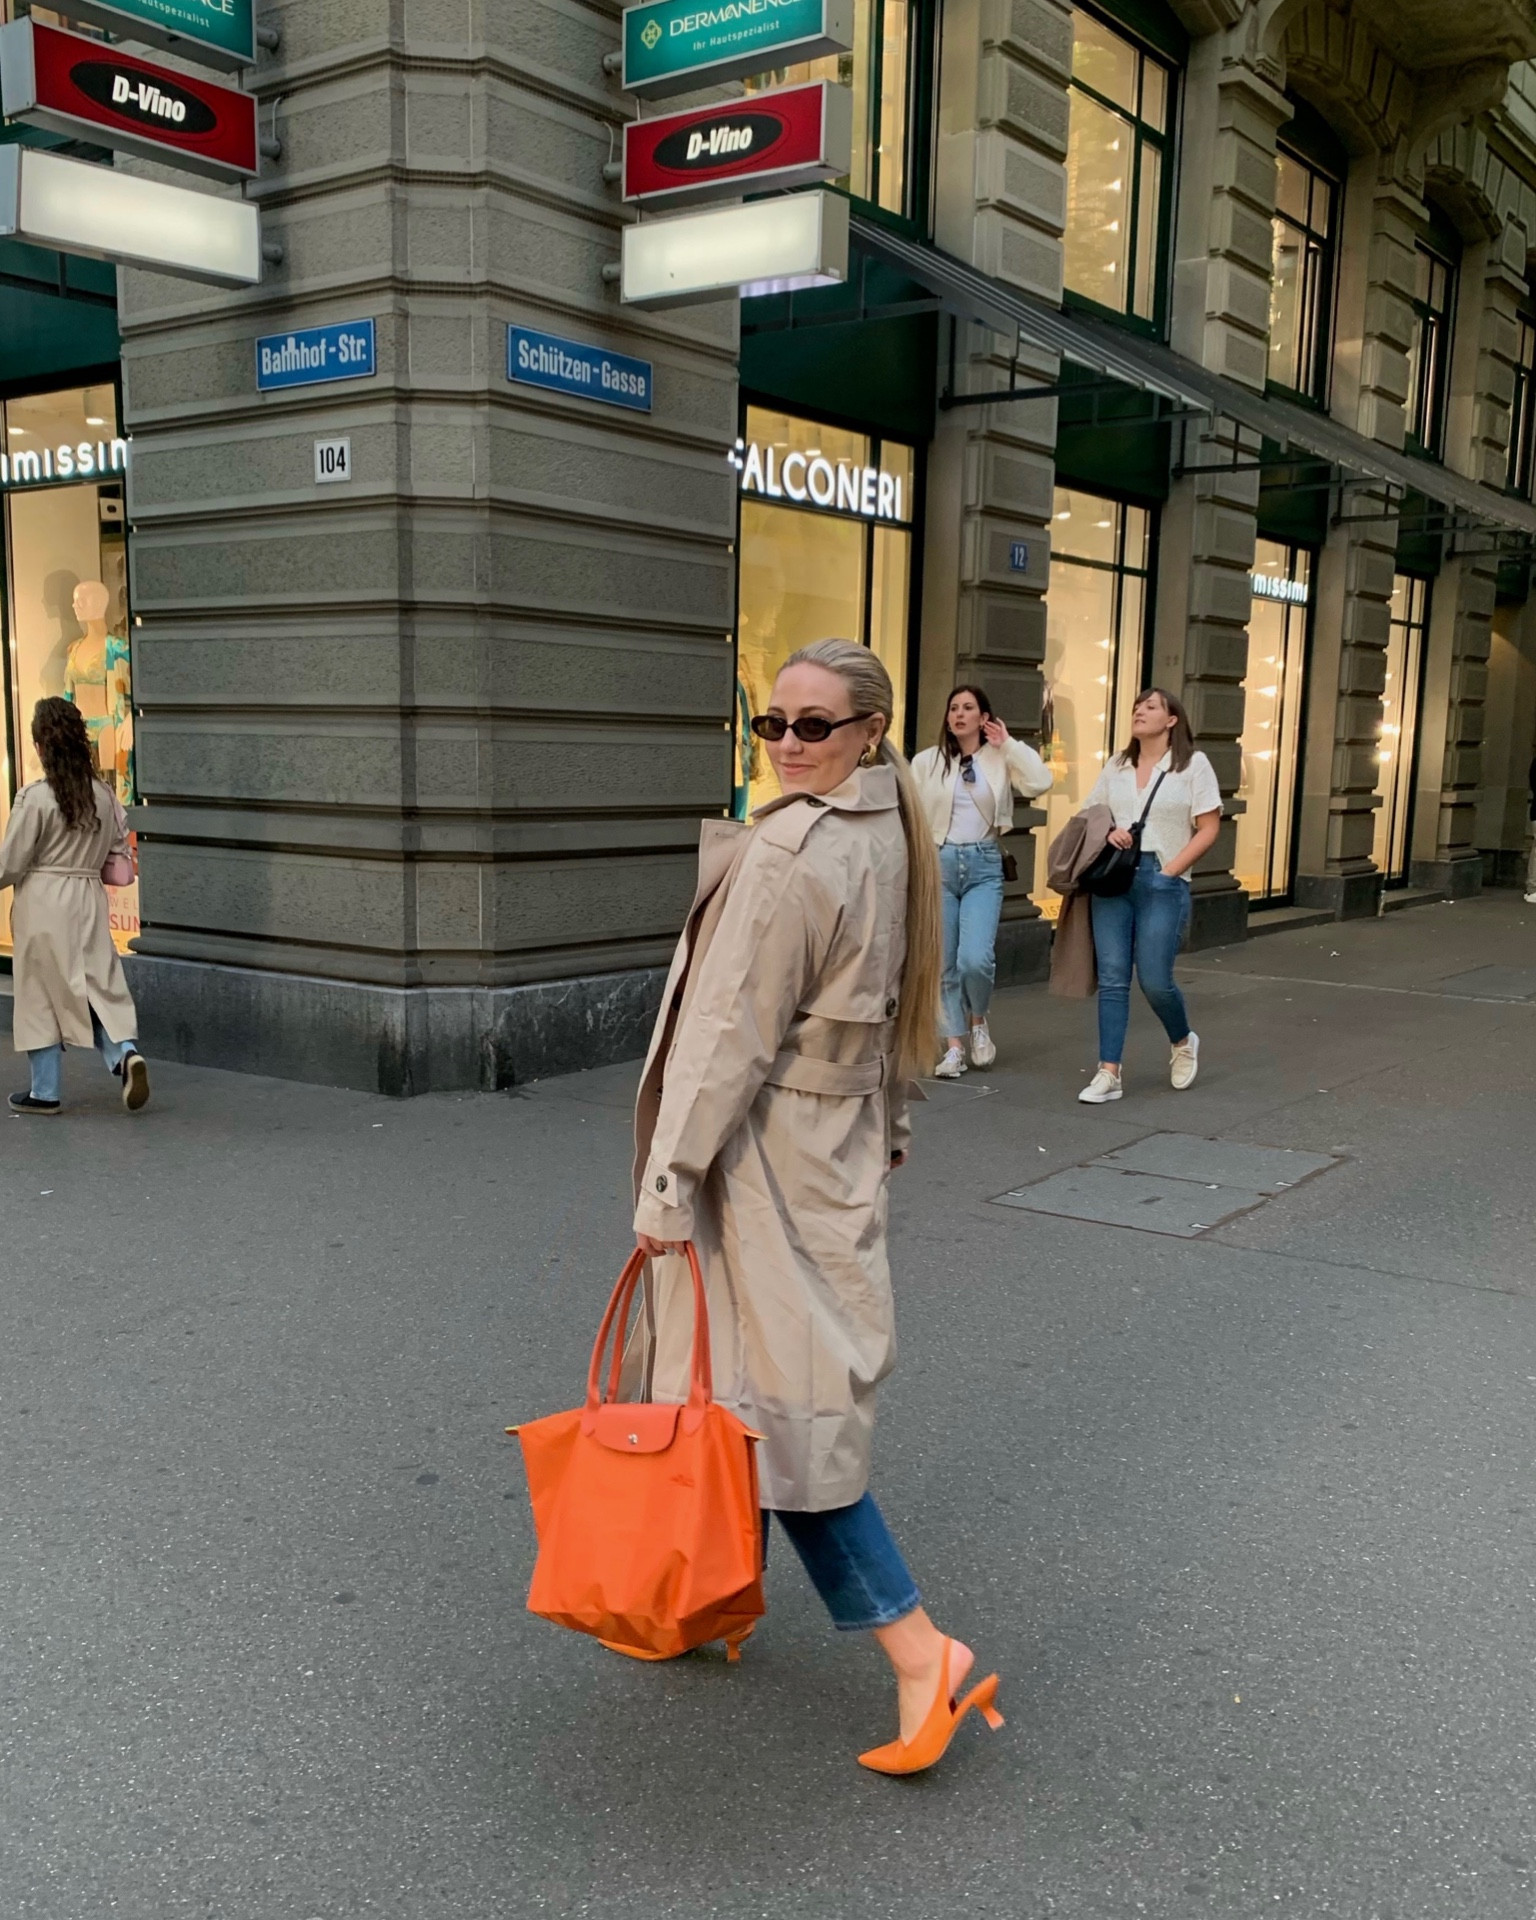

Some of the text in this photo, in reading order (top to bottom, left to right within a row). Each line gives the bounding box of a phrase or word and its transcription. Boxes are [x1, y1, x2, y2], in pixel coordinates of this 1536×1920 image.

[669, 0, 801, 37] DERMANEN
[692, 20, 780, 51] Ihr Hautspezialist
[112, 75, 186, 122] D-Vino
[686, 125, 753, 160] D-Vino
[518, 339, 646, 397] Schützen-Gasse
[319, 446, 346, 474] 104
[1014, 546, 1025, 567] 12
[1250, 572, 1309, 603] missimi
